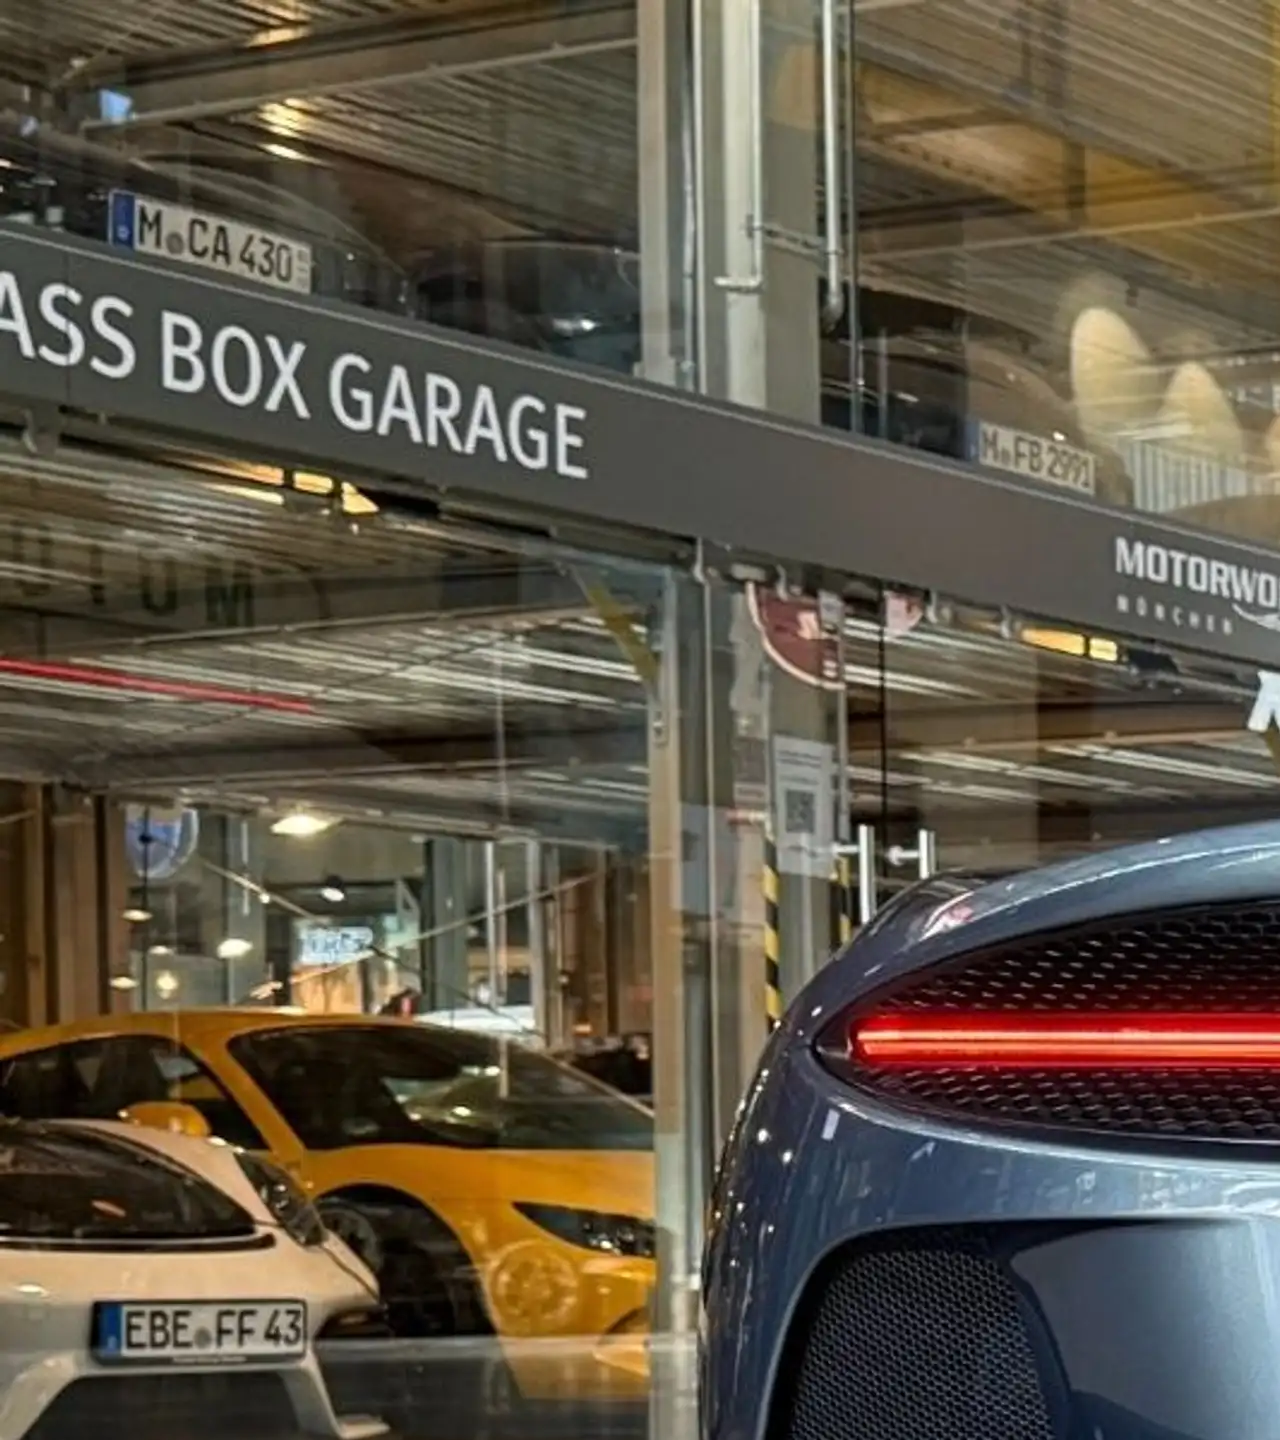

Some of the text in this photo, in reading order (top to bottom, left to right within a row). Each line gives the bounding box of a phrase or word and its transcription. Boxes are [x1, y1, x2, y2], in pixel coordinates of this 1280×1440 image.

[138, 203, 293, 283] M CA 430
[161, 309, 311, 419] BOX
[329, 352, 590, 480] GARAGE
[125, 1308, 301, 1350] EBE FF 43
